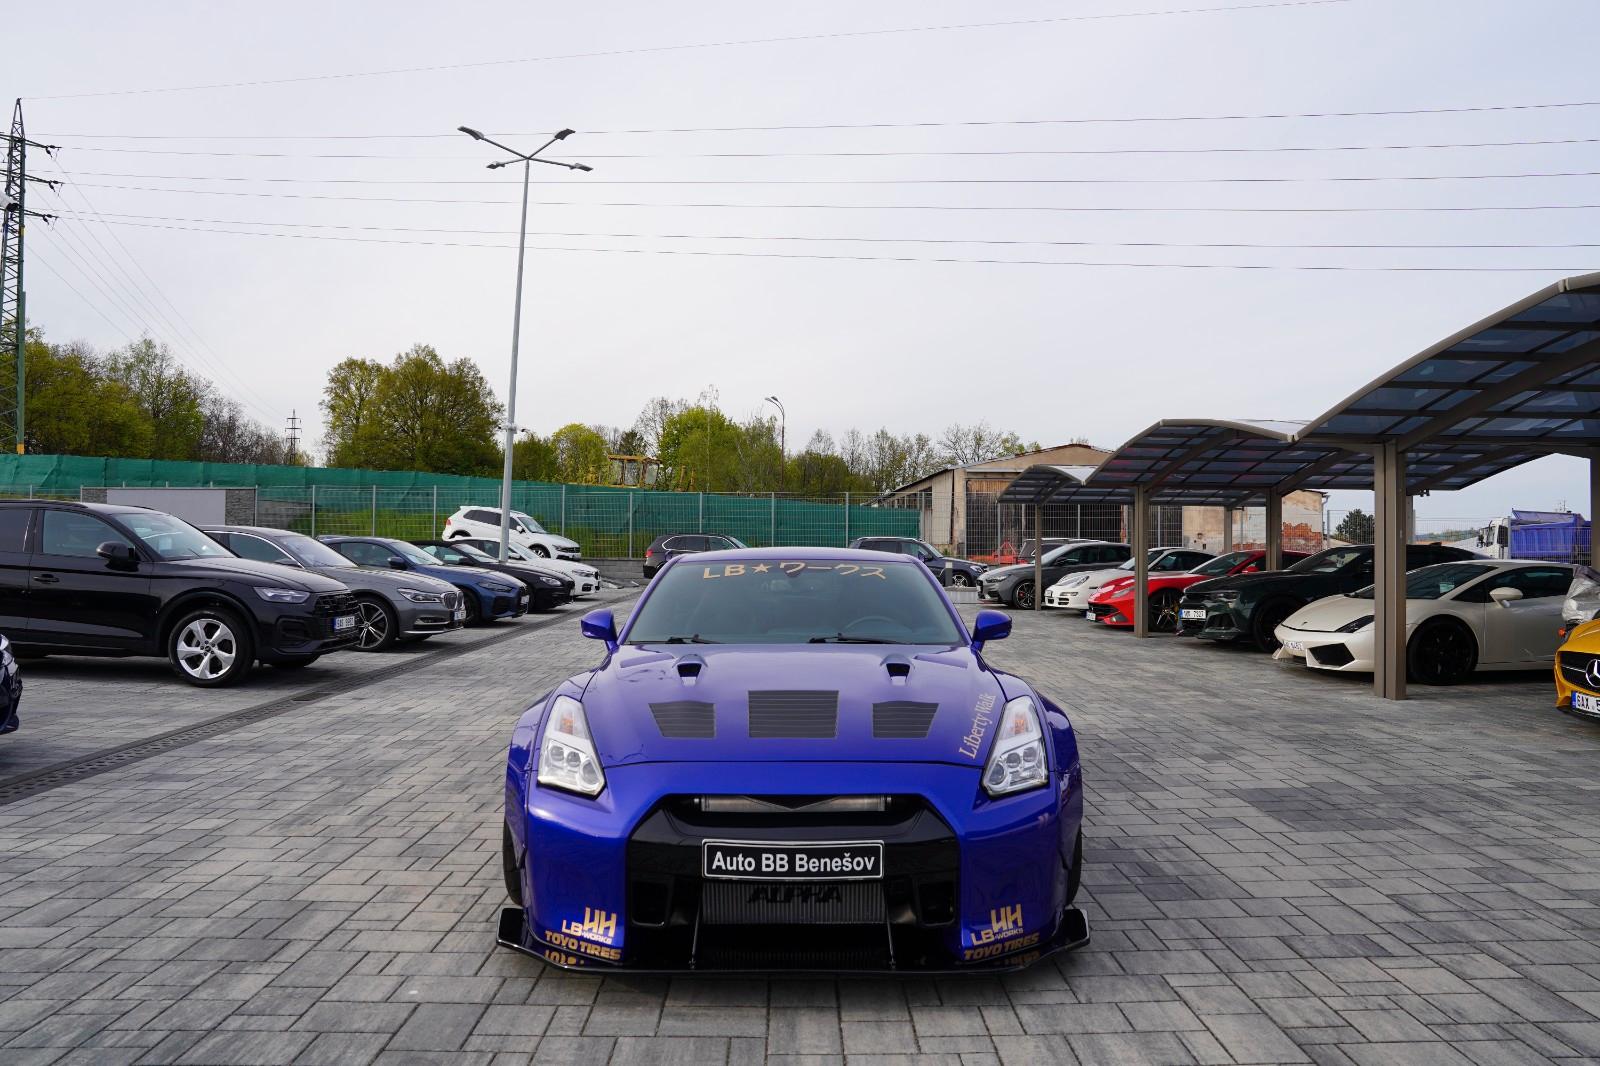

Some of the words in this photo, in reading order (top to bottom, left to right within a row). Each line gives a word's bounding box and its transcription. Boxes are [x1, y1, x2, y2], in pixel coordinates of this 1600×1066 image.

[974, 694, 996, 714] Walk
[958, 713, 993, 759] Liberty
[712, 851, 756, 871] Auto
[761, 853, 789, 872] BB
[795, 852, 875, 872] Benešov
[561, 919, 583, 936] LB
[970, 929, 995, 946] LB
[545, 930, 578, 950] TOYO
[580, 940, 621, 960] TIRES
[964, 943, 1002, 960] TOYO
[1004, 932, 1040, 951] TIRES
